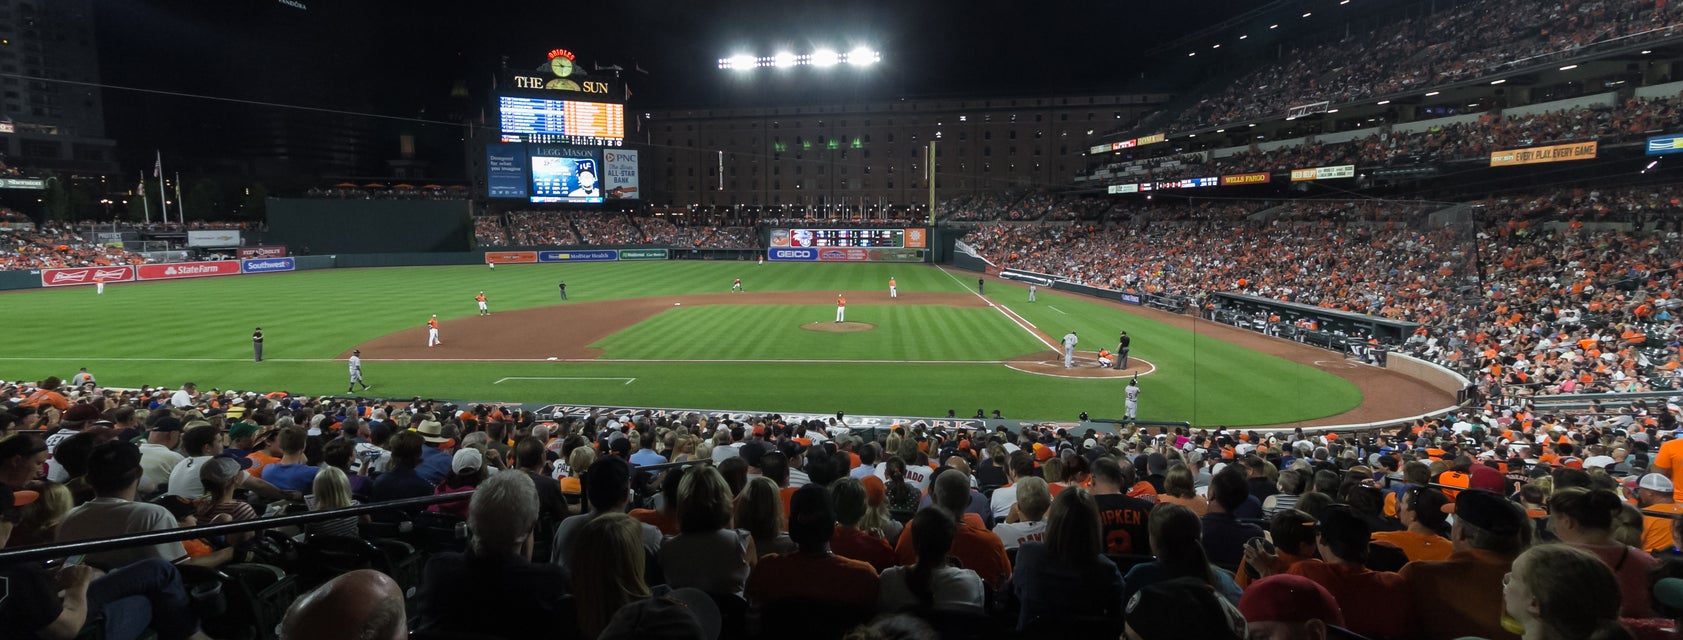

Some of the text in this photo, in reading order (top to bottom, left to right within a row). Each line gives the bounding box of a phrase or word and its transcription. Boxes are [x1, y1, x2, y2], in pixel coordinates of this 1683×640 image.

[548, 49, 576, 60] ORIOLES
[515, 76, 608, 93] THE SUN
[537, 147, 593, 157] LEGG MASON
[1516, 152, 1534, 161] EVERY
[1536, 150, 1551, 159] PLAY.
[1553, 147, 1573, 158] EVERY
[1575, 145, 1594, 155] GAME.
[617, 154, 636, 162] PNC
[777, 250, 810, 258] GEICO
[248, 261, 285, 270] Southwest
[892, 418, 976, 429] PARK
